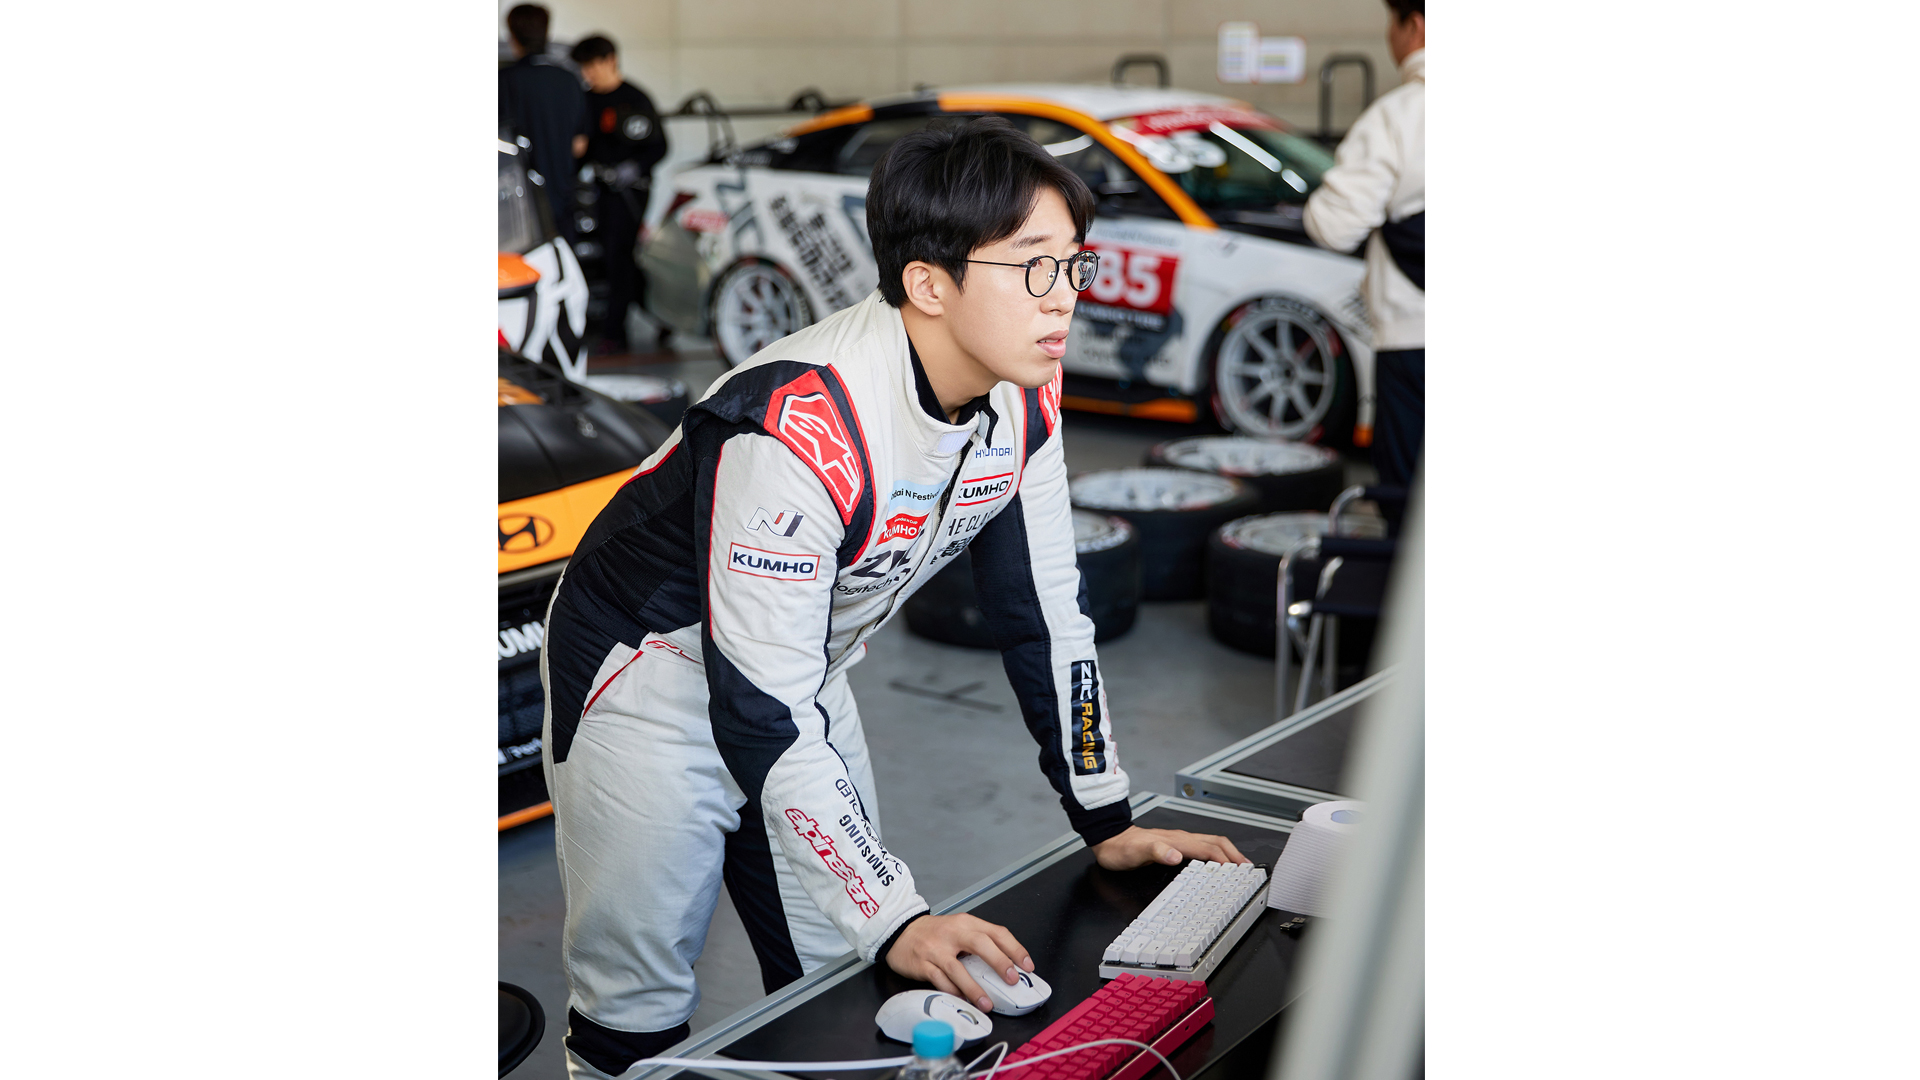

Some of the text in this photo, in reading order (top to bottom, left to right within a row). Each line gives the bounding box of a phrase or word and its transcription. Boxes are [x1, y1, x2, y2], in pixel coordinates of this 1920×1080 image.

[1087, 248, 1162, 309] 85
[975, 447, 1013, 459] HYUNDAI
[905, 489, 912, 497] N
[883, 524, 918, 539] KUMHO
[948, 516, 967, 536] HE
[732, 551, 815, 574] KUMHO
[1080, 662, 1098, 770] ZIC RACING
[838, 814, 895, 888] SAMSUNG
[784, 807, 880, 919] alpinestars
